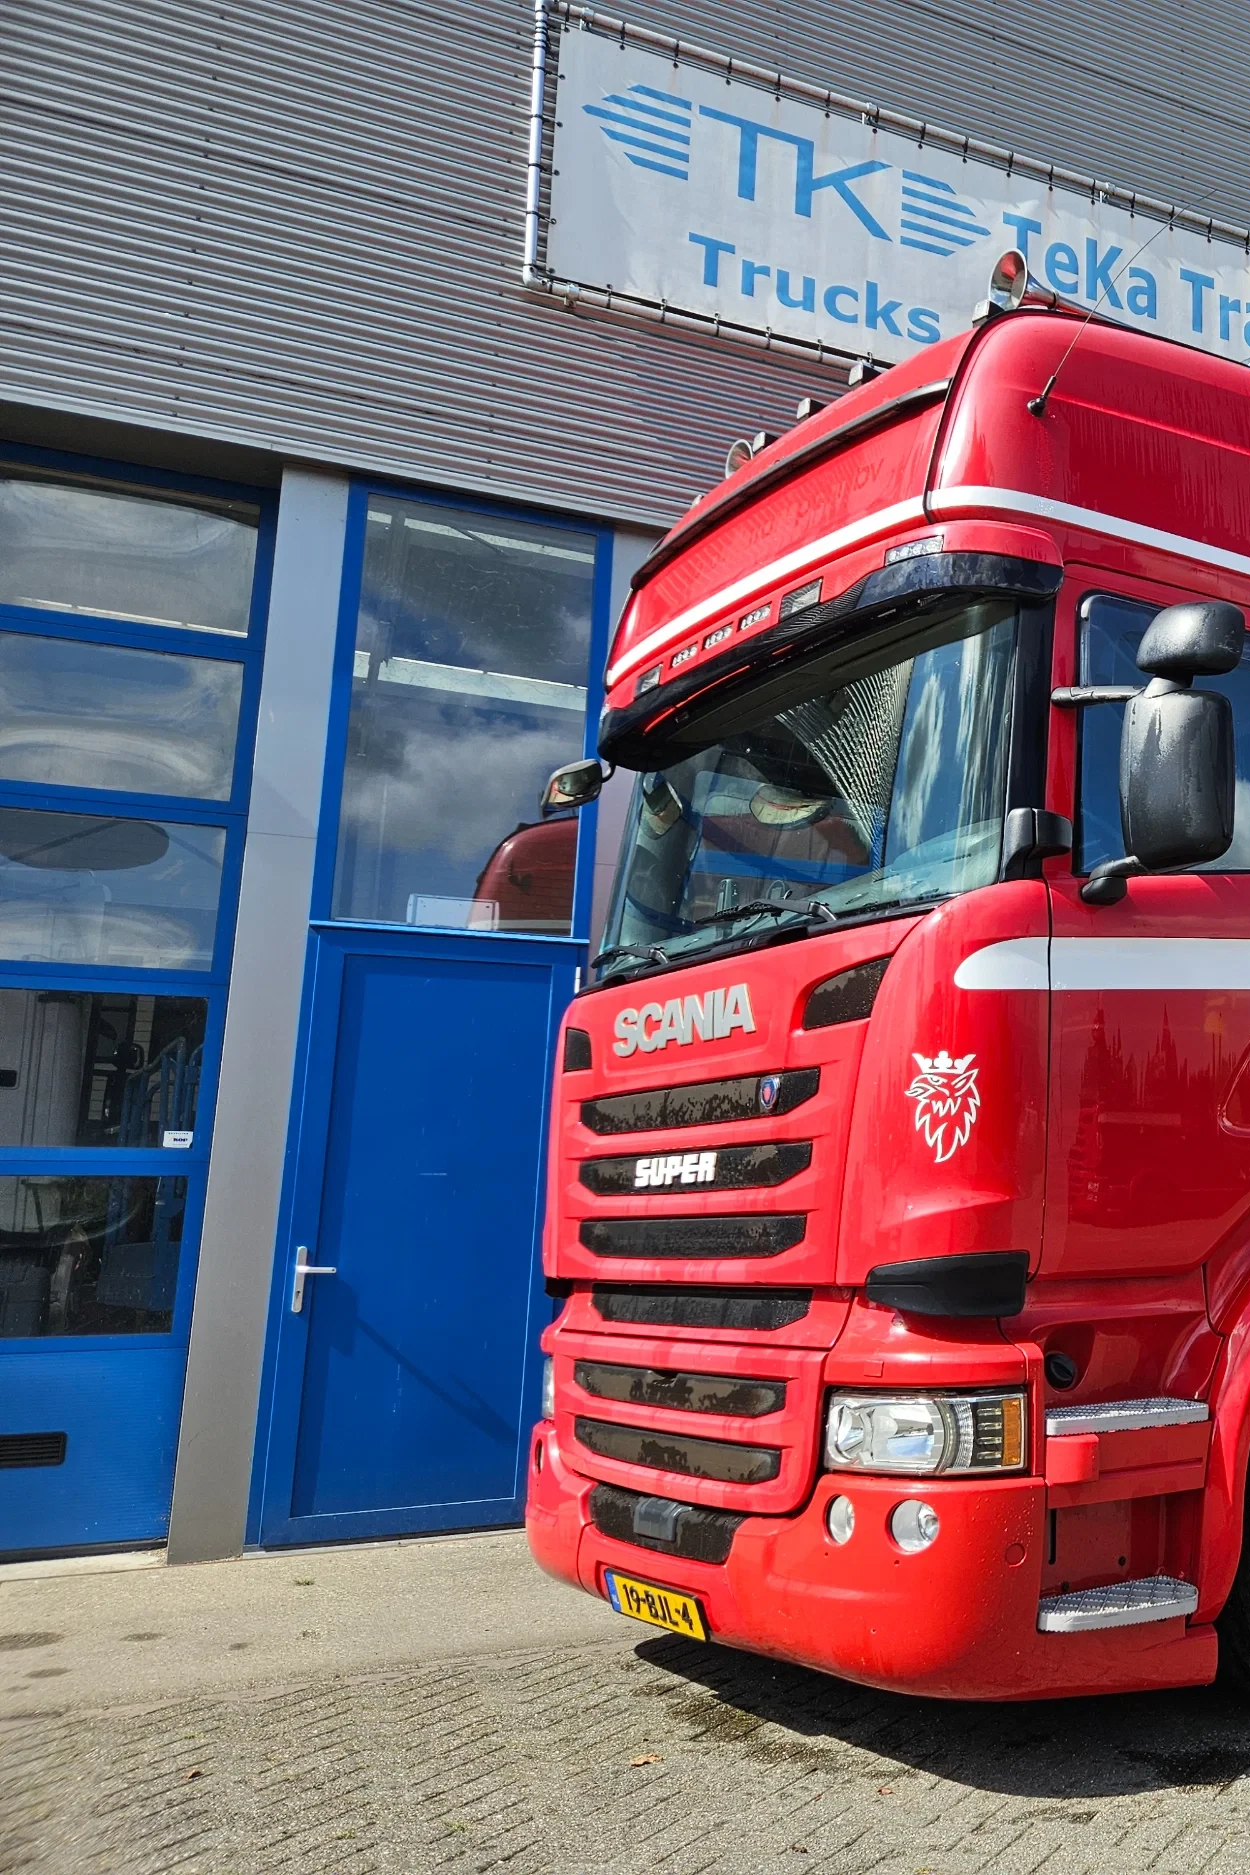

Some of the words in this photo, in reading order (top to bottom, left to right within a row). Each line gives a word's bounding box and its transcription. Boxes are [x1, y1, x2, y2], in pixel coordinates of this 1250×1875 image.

[687, 232, 941, 345] Trucks
[1002, 211, 1158, 320] TeKa
[612, 983, 757, 1058] SCANIA
[634, 1152, 718, 1187] SUPER
[622, 1583, 695, 1632] 19-BJL-4
